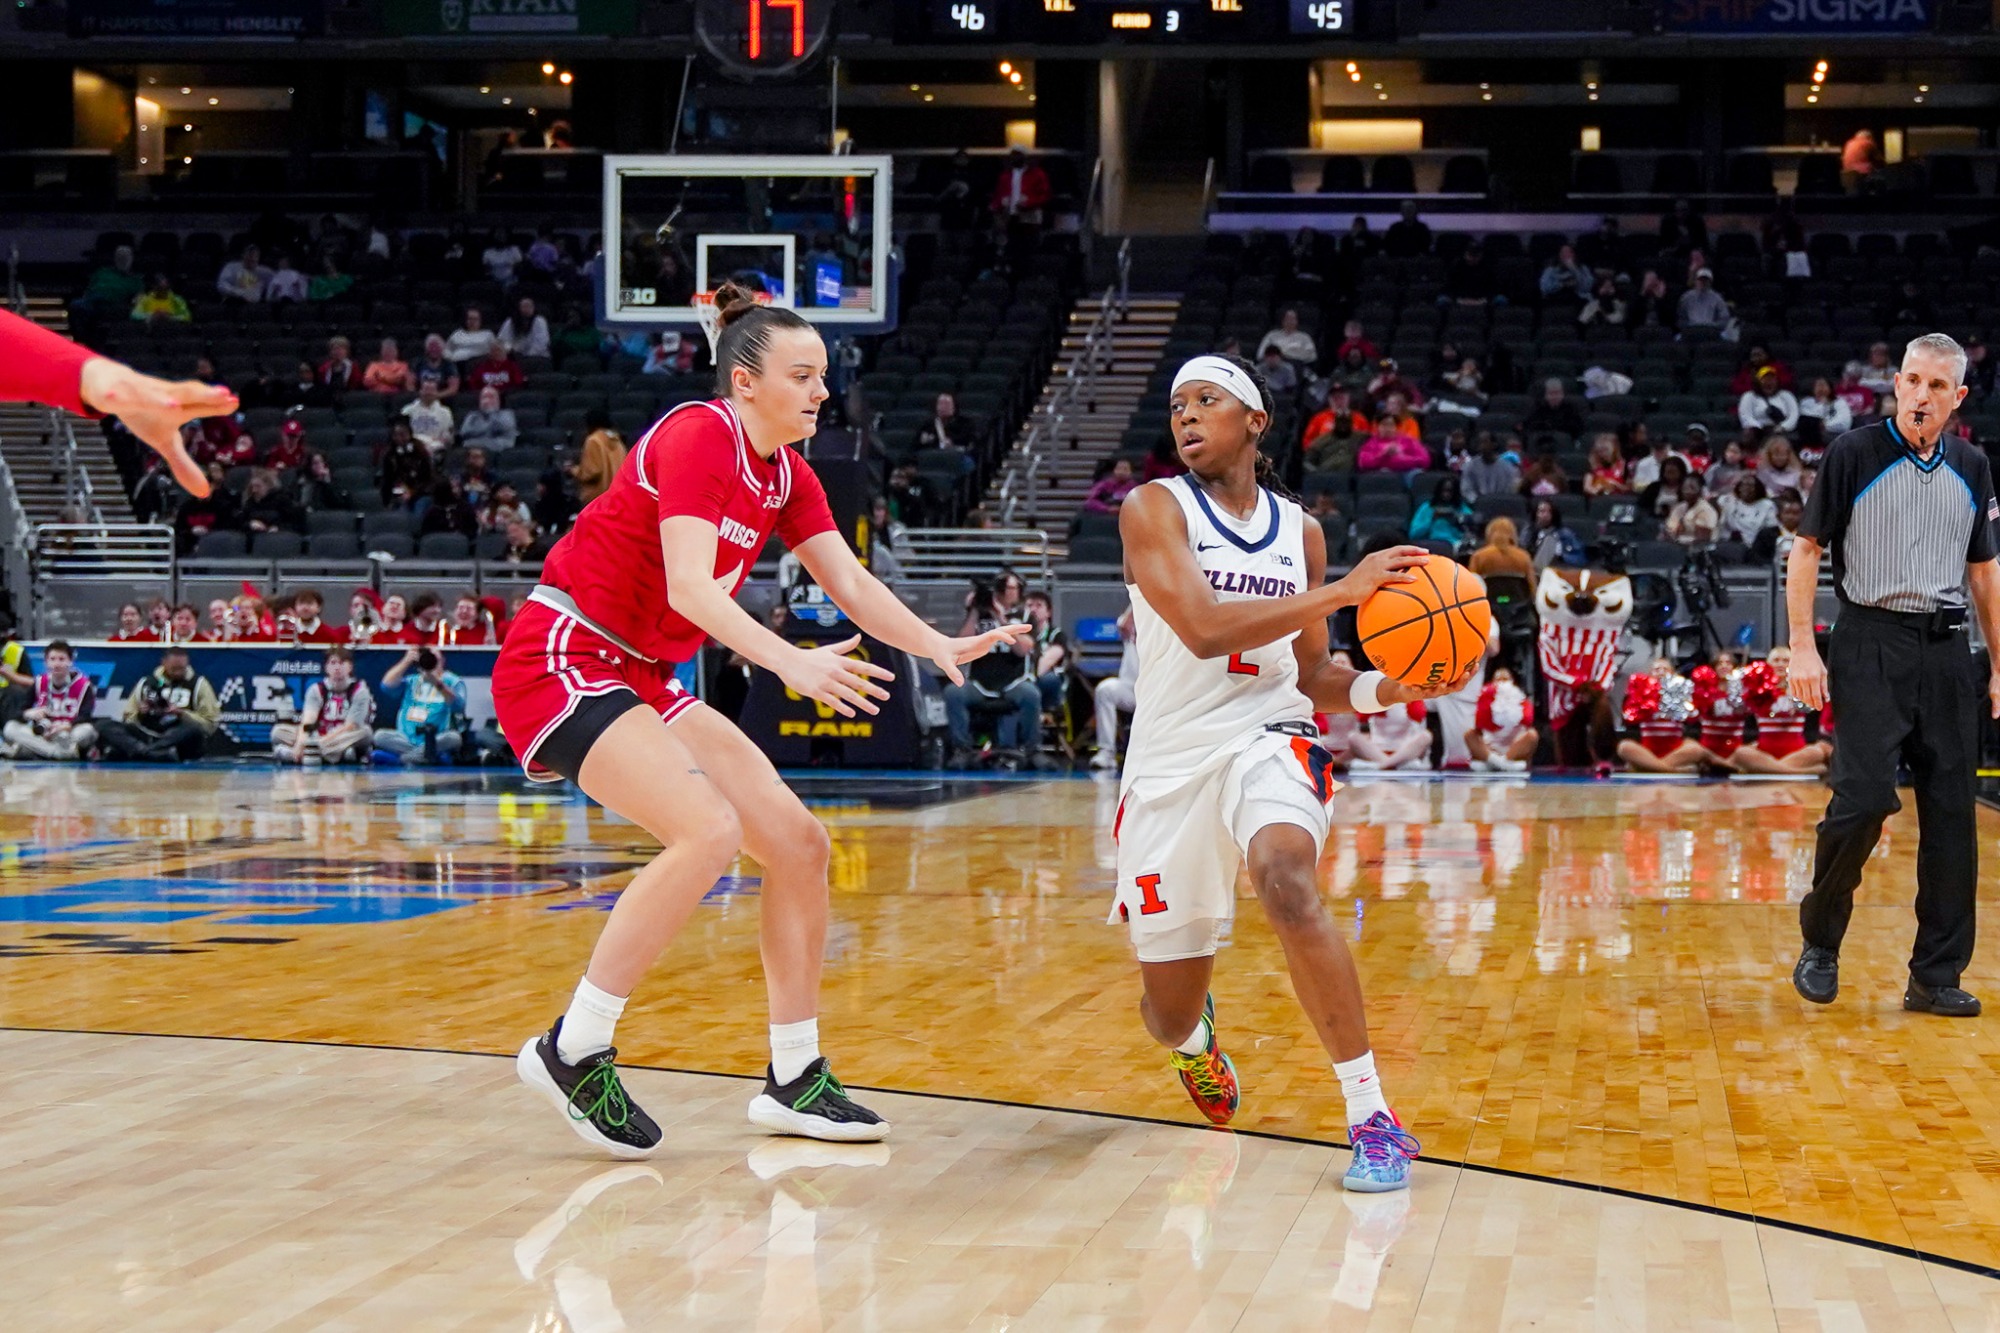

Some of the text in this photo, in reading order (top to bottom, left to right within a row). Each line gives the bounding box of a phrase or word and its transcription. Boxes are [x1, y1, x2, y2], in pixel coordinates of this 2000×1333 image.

[951, 4, 985, 31] 46
[1112, 10, 1180, 32] PERIOD 3
[1308, 1, 1343, 30] 45
[1769, 0, 1926, 22] SIGMA
[749, 0, 804, 58] 17
[1203, 569, 1296, 598] LLINOIS
[271, 660, 321, 674] Allstate
[219, 711, 257, 723] OMEN'S
[779, 720, 873, 738] RAM
[1136, 873, 1169, 916] I
